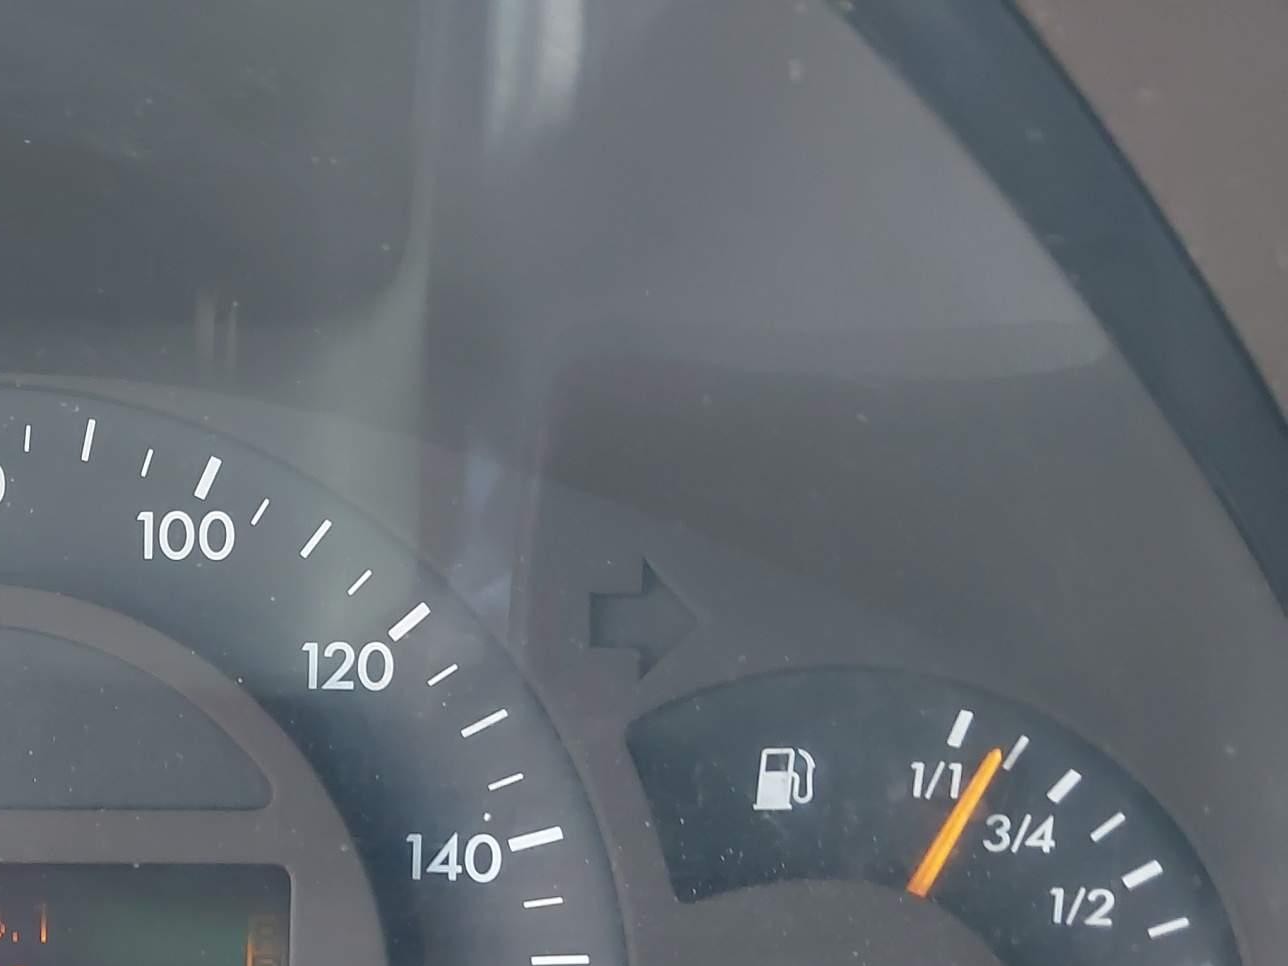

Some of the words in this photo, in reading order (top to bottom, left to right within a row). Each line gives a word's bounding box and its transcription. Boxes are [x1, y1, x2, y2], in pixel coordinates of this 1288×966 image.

[137, 510, 235, 561] 100
[301, 641, 394, 692] 120
[911, 761, 963, 800] 1/1
[983, 815, 1055, 854] 3/4
[406, 833, 502, 884] 140
[1050, 887, 1114, 927] 1/2
